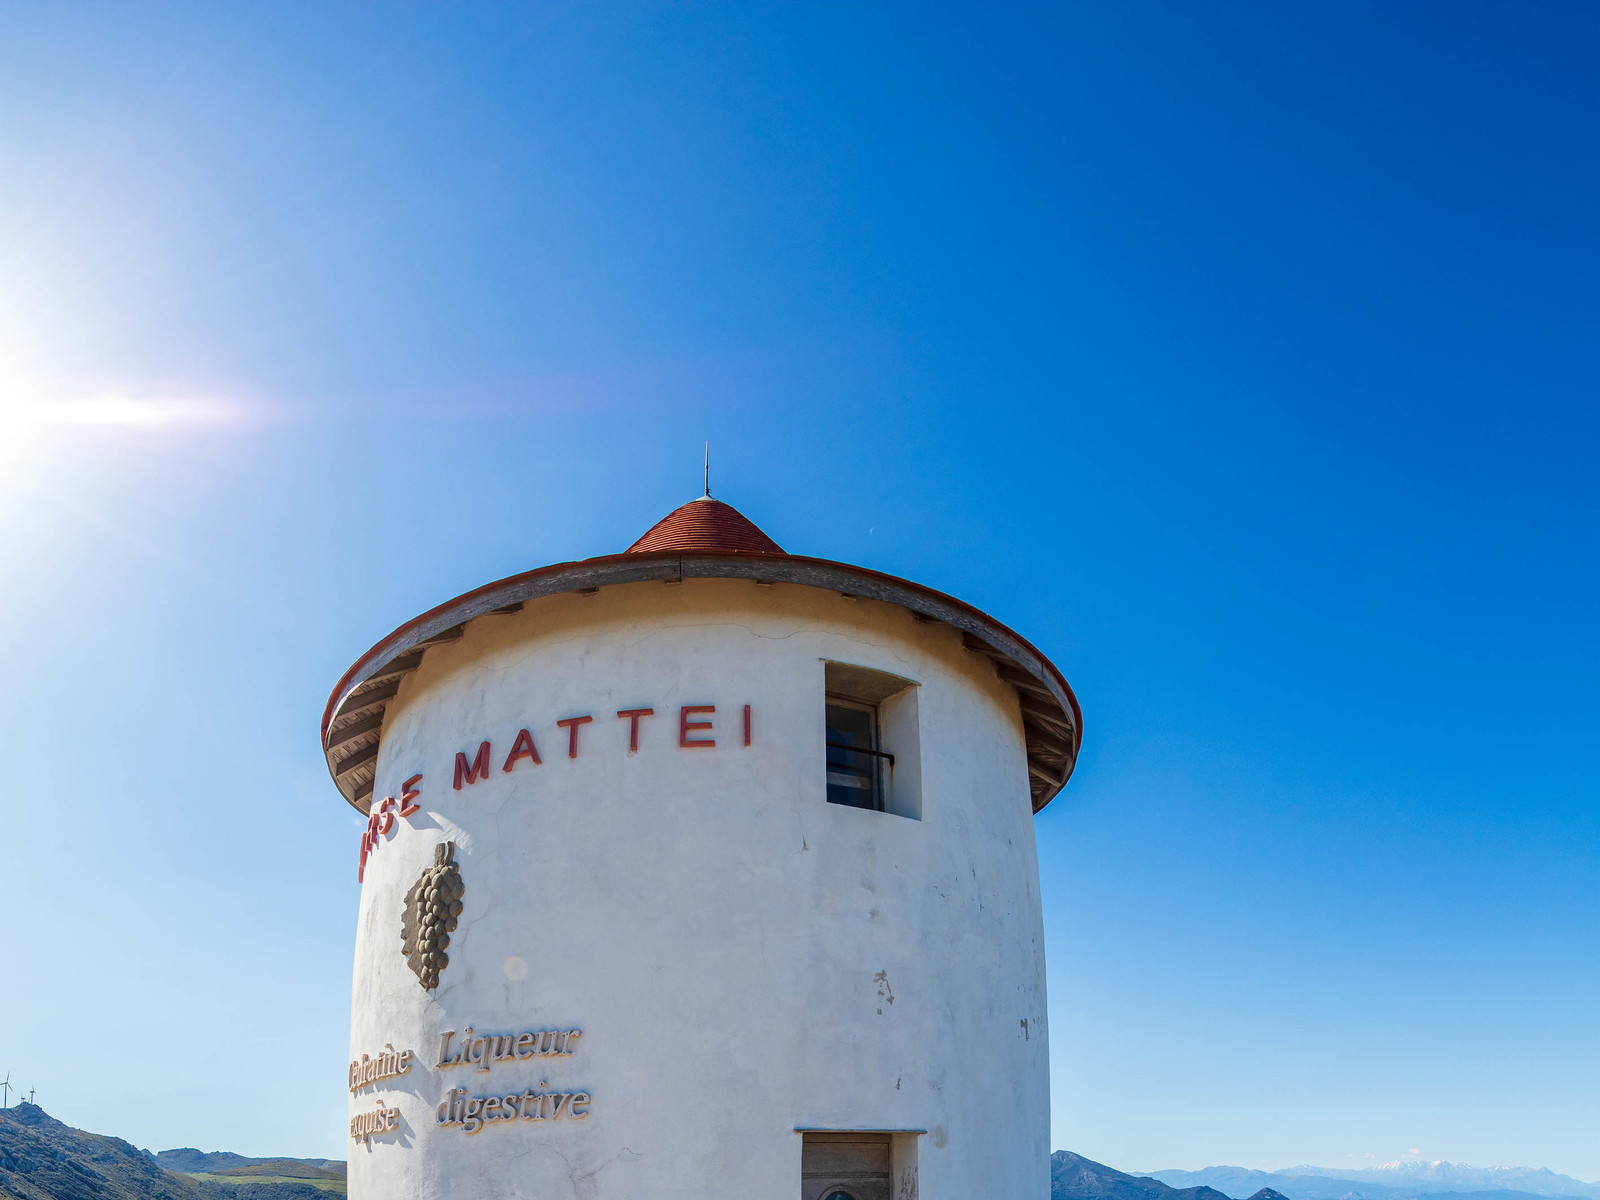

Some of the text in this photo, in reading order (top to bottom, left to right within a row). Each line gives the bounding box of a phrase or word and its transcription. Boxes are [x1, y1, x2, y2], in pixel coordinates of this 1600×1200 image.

[453, 704, 752, 791] MATTEI
[435, 1027, 583, 1073] Liqueur
[435, 1081, 592, 1135] digestive
